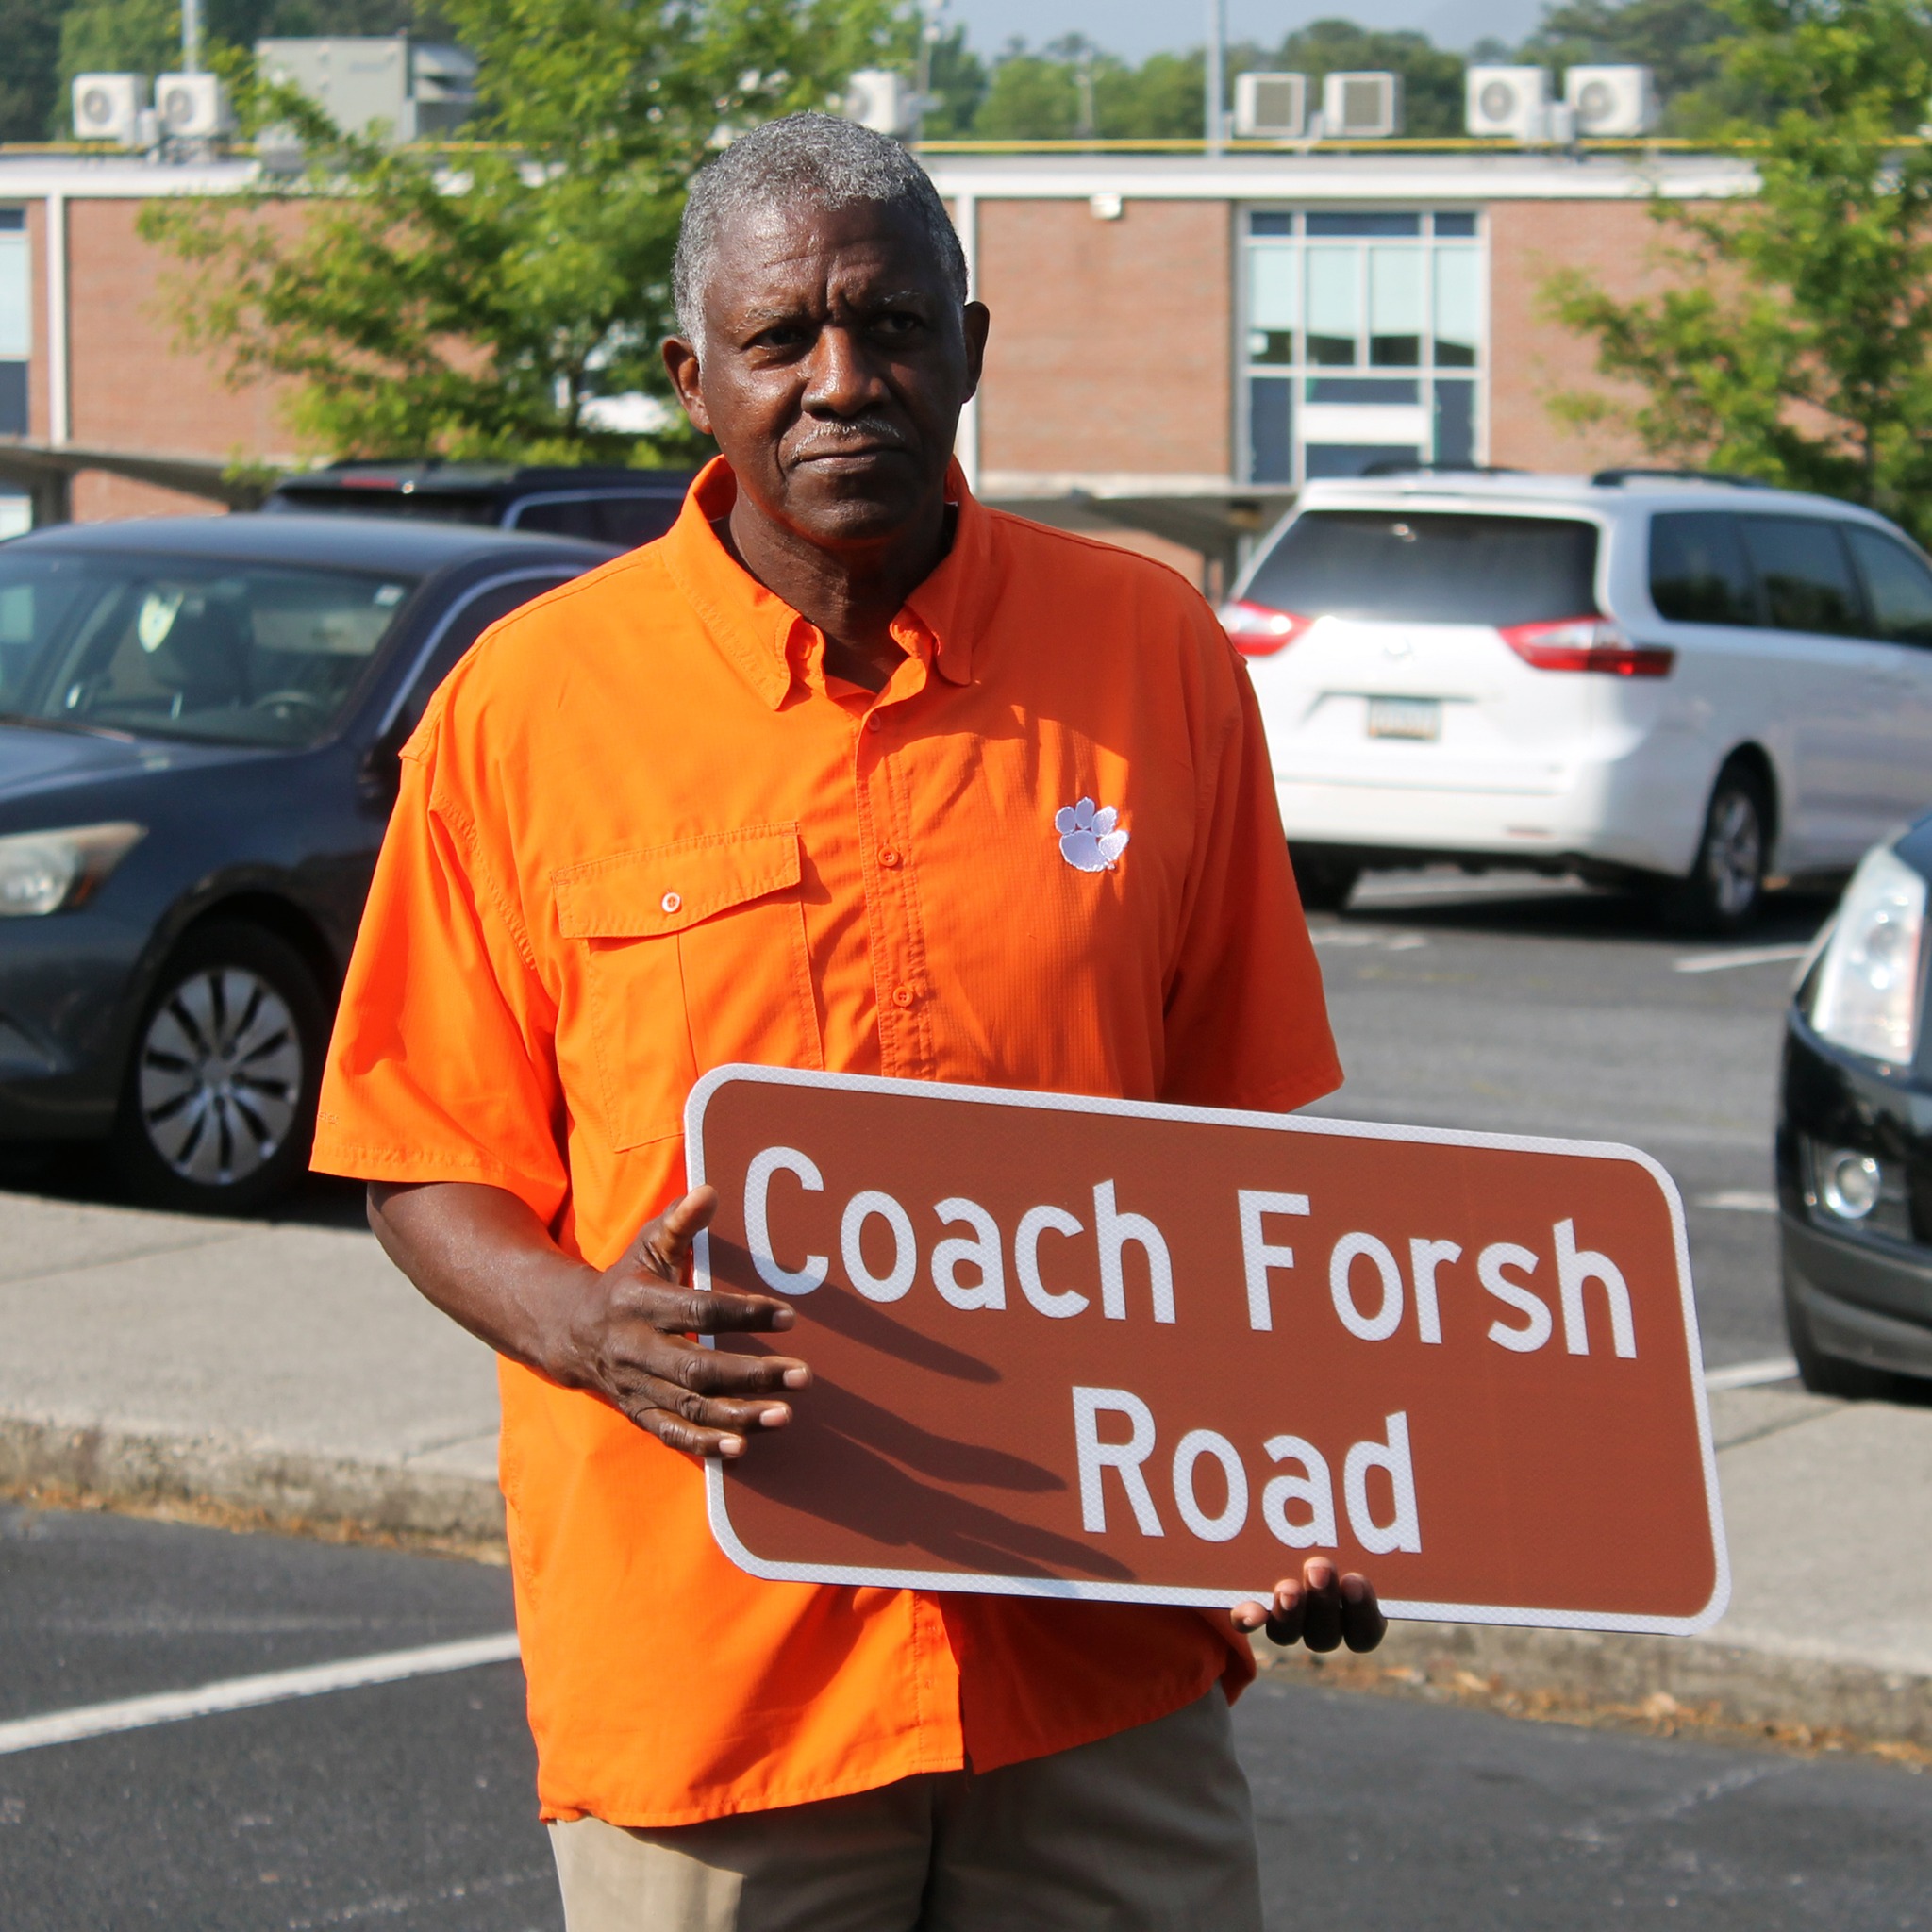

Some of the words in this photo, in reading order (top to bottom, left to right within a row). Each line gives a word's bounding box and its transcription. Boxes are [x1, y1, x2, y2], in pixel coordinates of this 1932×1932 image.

[744, 1146, 1175, 1324] Coach
[1238, 1190, 1637, 1358] Forsh
[1072, 1386, 1422, 1554] Road
